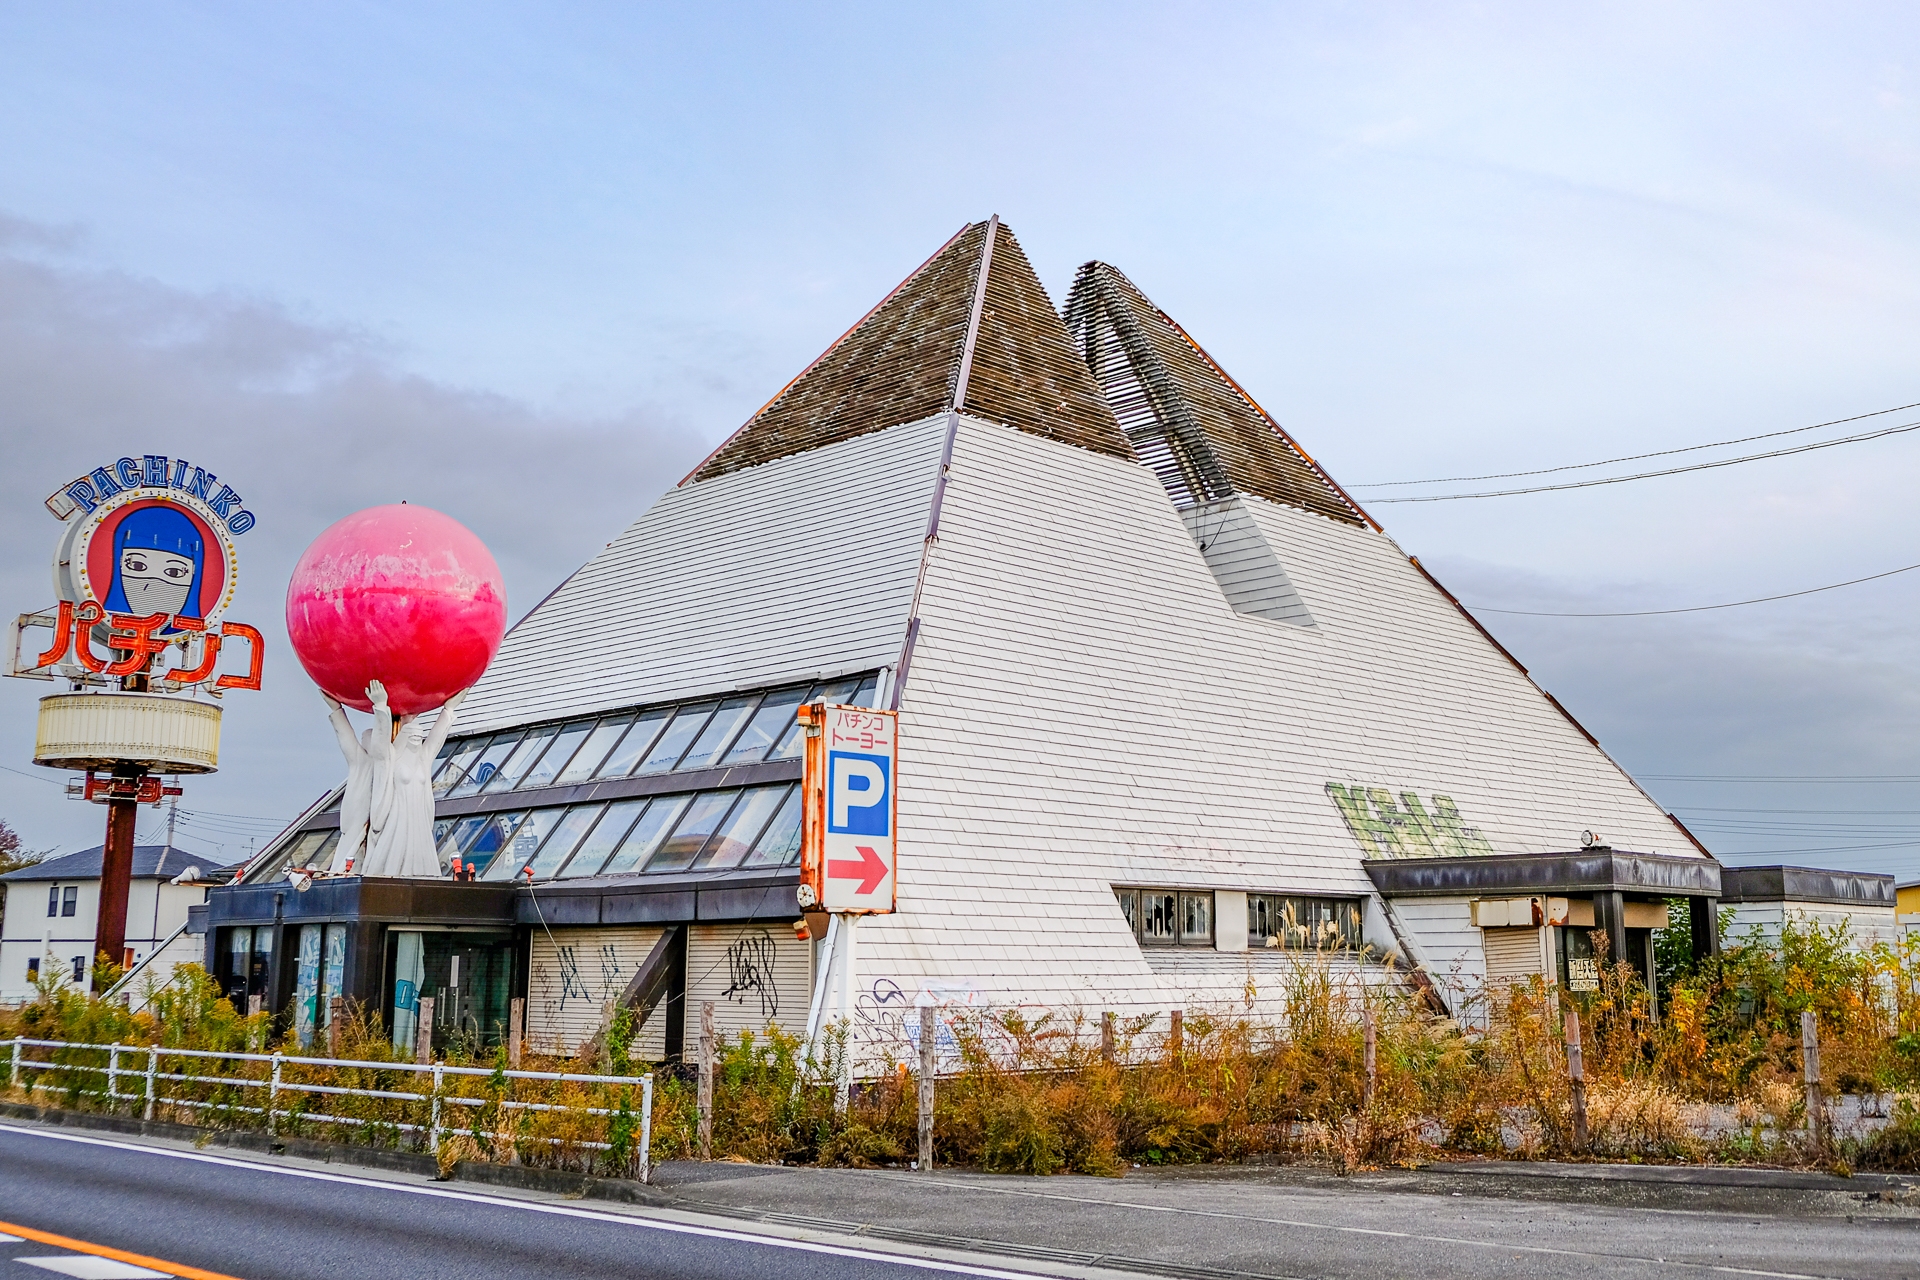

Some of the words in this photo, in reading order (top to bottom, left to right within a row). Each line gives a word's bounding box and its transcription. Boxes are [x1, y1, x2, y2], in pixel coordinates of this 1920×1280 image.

[67, 454, 256, 535] PACHINKO
[37, 599, 265, 690] パチンコ
[832, 728, 888, 749] トーヨー
[838, 712, 884, 731] パチンコ
[833, 757, 885, 827] P
